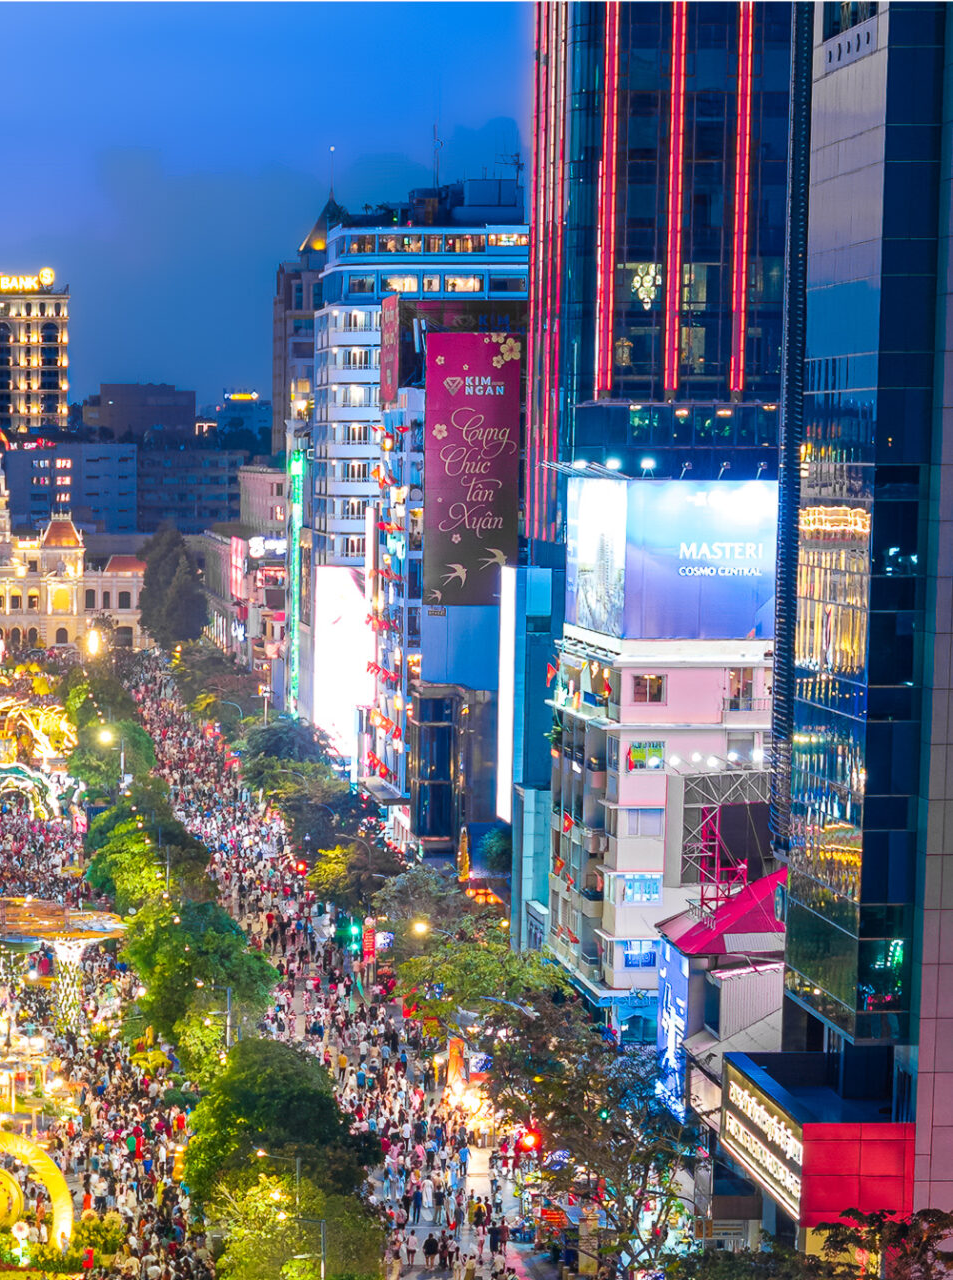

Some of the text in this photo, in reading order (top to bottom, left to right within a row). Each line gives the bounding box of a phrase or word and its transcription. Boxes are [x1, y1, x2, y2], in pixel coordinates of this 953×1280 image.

[465, 376, 491, 385] KIM
[465, 385, 505, 395] NGAN
[438, 502, 504, 539] Xuân
[678, 542, 763, 560] MASTERI
[678, 566, 762, 577] COSMO CENTRAL
